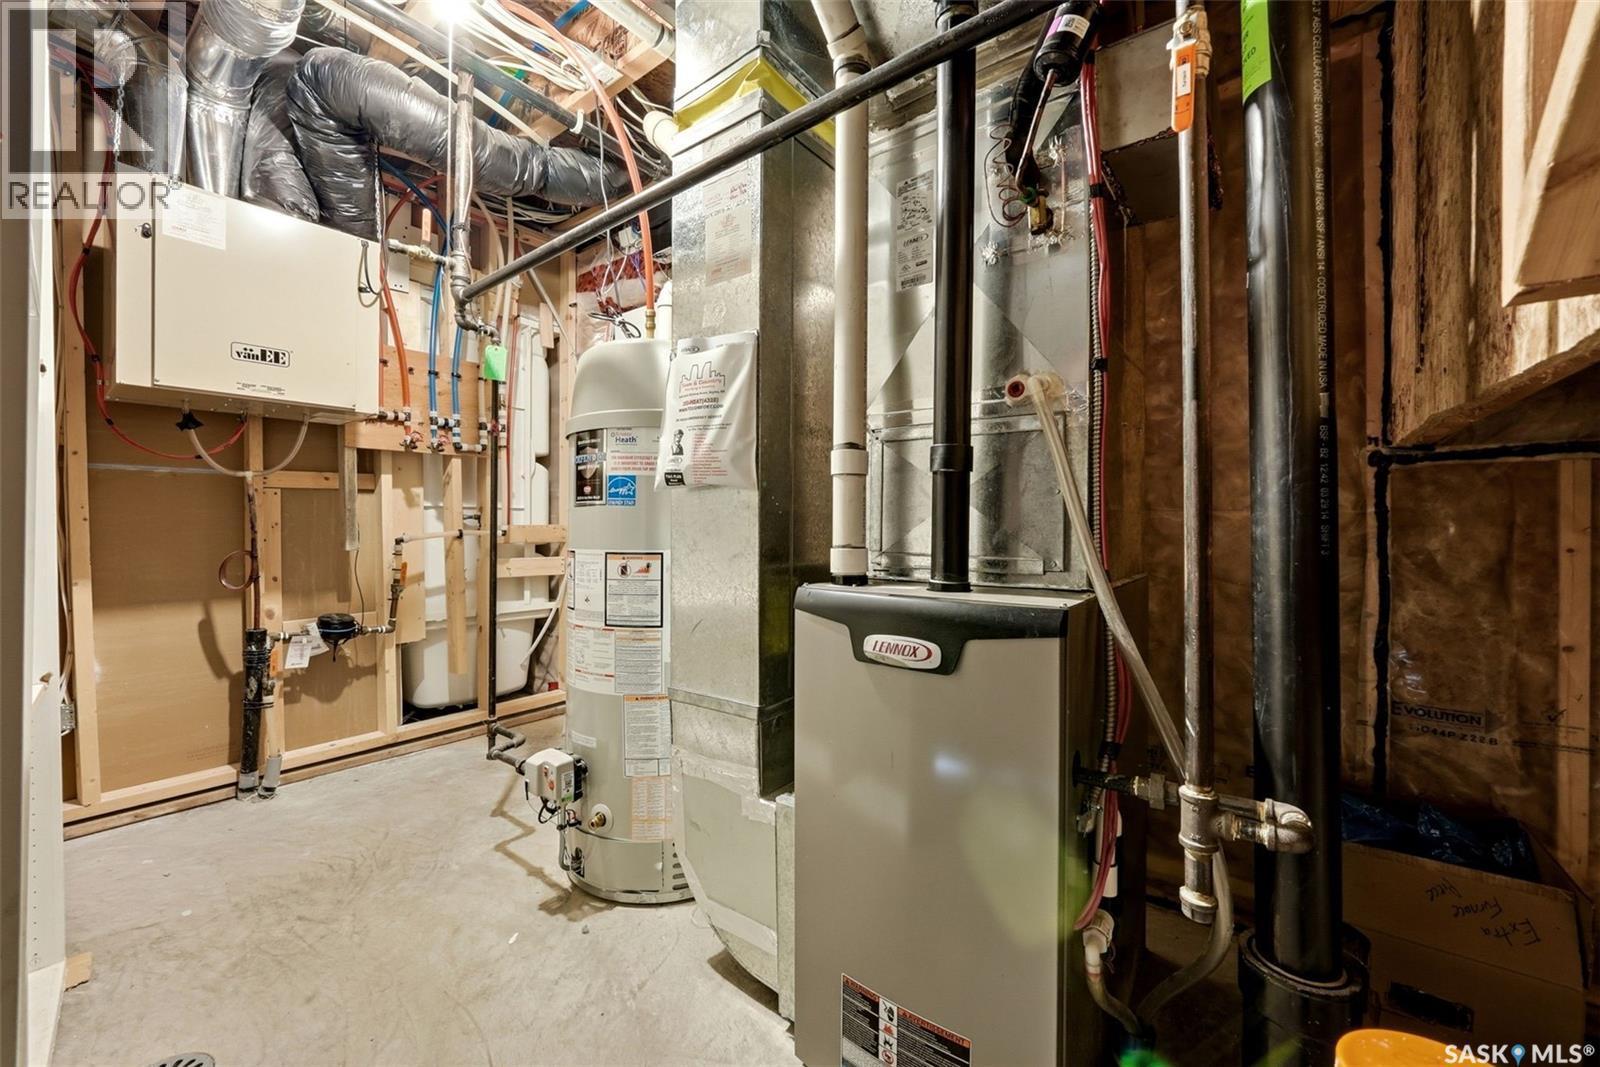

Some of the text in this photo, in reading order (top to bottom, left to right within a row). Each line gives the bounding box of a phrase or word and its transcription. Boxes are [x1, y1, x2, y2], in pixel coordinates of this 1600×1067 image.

[1312, 16, 1322, 34] ABS
[1312, 34, 1323, 77] CELLULAR
[1313, 78, 1324, 106] CORE
[1315, 166, 1325, 191] ASTM
[1316, 216, 1326, 233] NSF
[1316, 238, 1326, 260] ANSI
[1317, 260, 1326, 271] 14
[1317, 276, 1328, 334] COEXTRUDED
[1318, 334, 1329, 359] MADE
[1319, 359, 1329, 370] IN
[1319, 370, 1329, 389] USA
[872, 640, 920, 658] LENNOX
[1480, 918, 1541, 947] Extra
